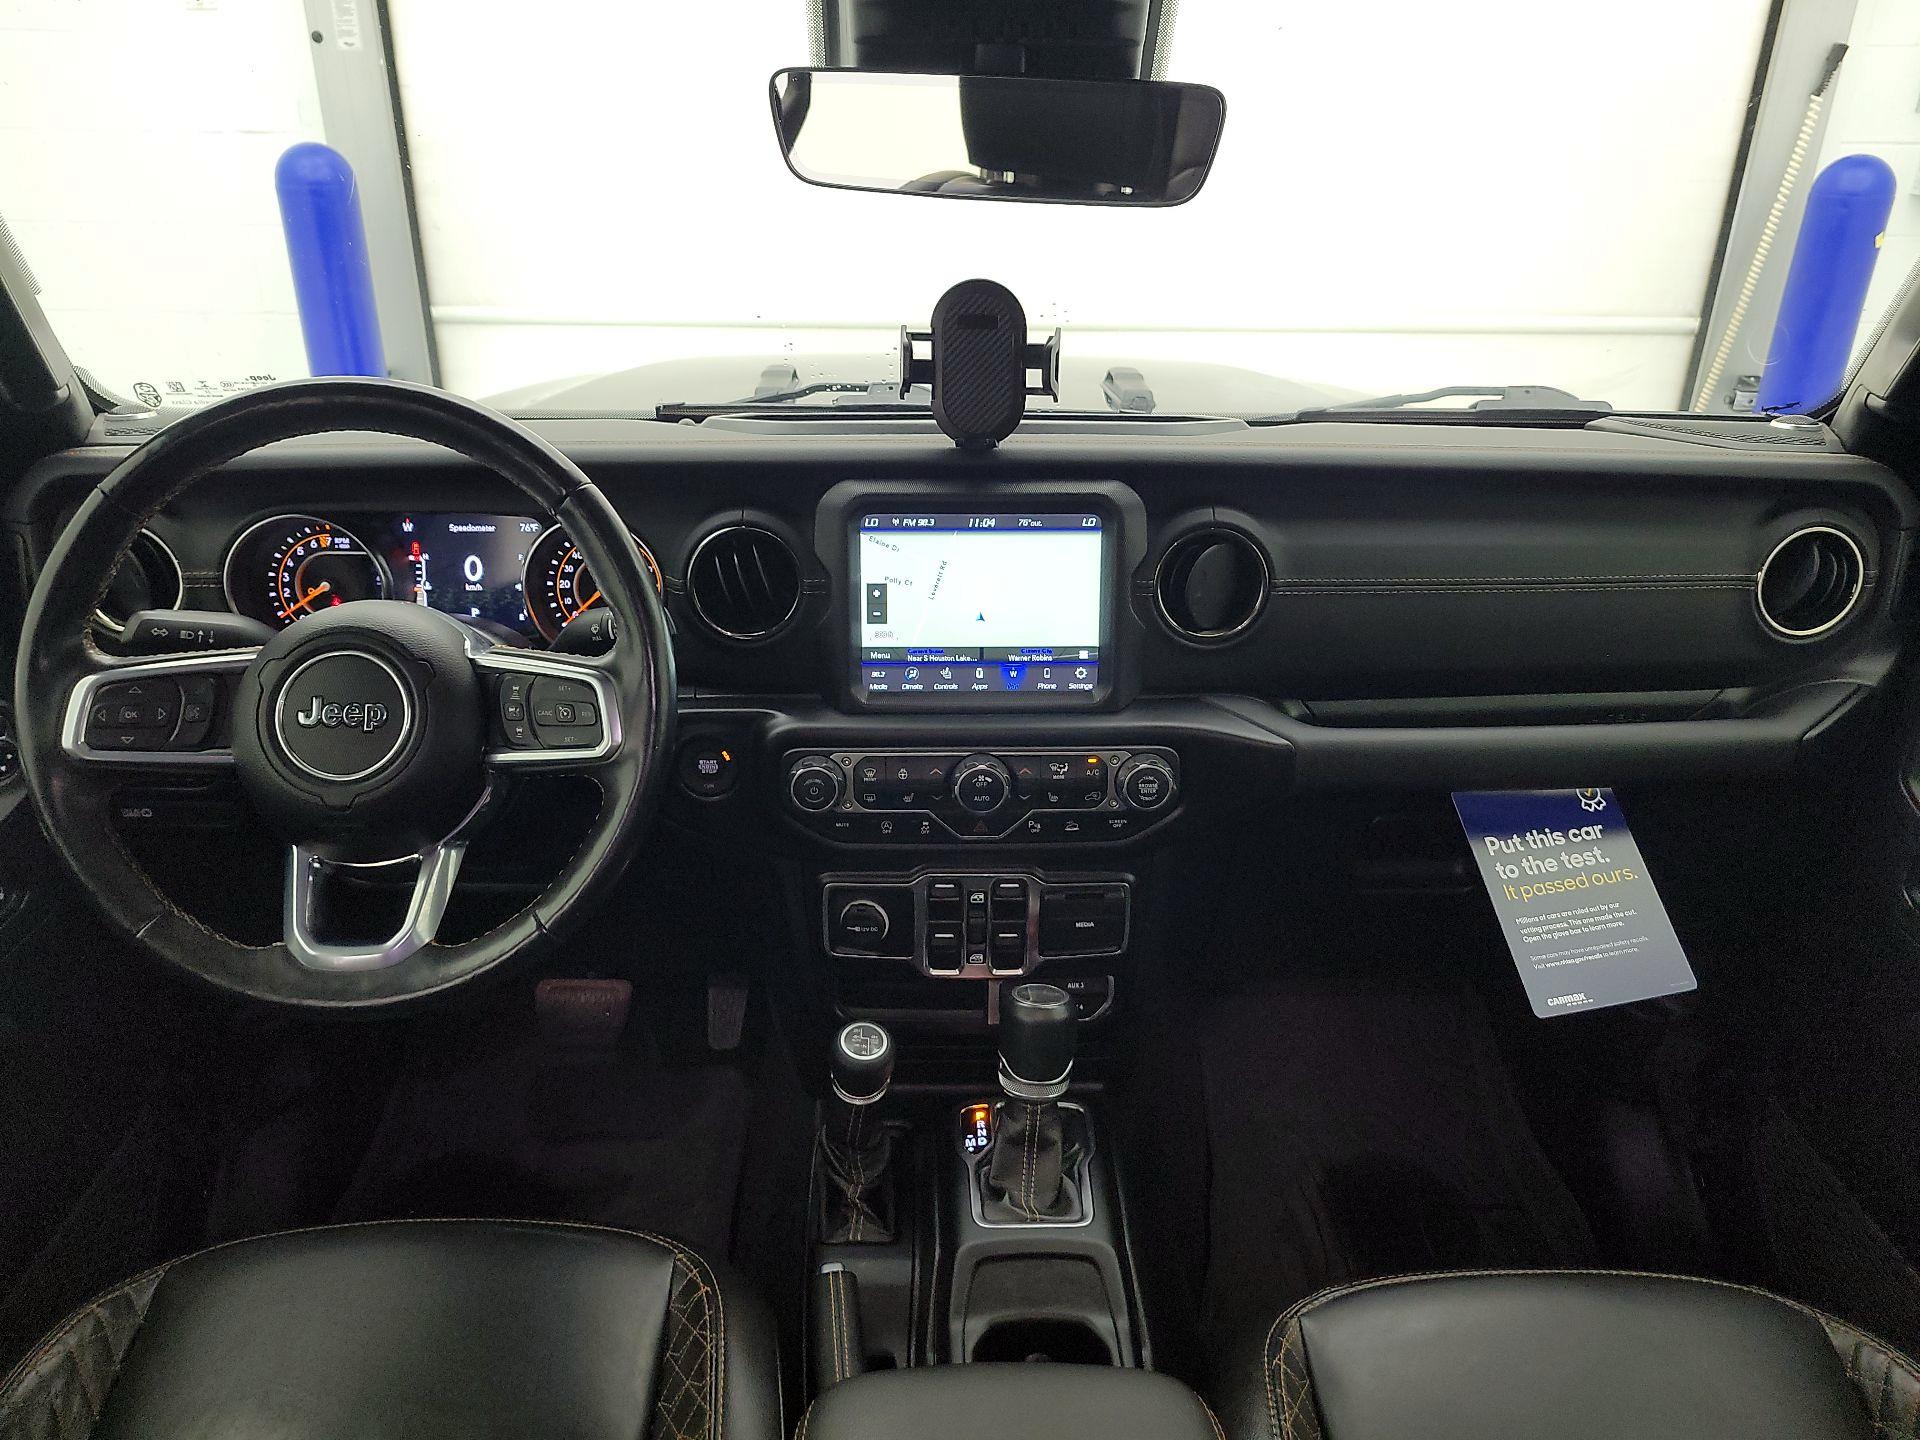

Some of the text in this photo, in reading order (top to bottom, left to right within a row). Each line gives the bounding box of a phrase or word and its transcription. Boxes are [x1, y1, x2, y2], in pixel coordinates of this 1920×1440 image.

[402, 522, 414, 532] W
[903, 518, 916, 527] FM
[969, 517, 996, 528] 11:04
[448, 523, 497, 533] Speedometer
[310, 539, 318, 549] 6
[326, 536, 332, 546] 7
[296, 546, 305, 556] 5
[286, 558, 294, 568] 4
[464, 555, 483, 581] 0
[563, 564, 574, 573] 30
[282, 572, 290, 582] 3
[884, 576, 902, 586] Polly
[559, 580, 571, 589] 20
[283, 587, 291, 598] 2
[564, 597, 572, 605] 10
[471, 607, 480, 618] P
[870, 651, 891, 660] Menu
[907, 654, 923, 662] Near
[929, 654, 955, 662] Houston
[1007, 653, 1053, 662] Warner Robins
[971, 683, 988, 691] Apps
[1068, 683, 1093, 691] Settings
[124, 711, 138, 719] OK
[297, 695, 388, 732] Jeep
[1484, 824, 1603, 856] Put this car
[1495, 846, 1611, 880] to the test.
[1503, 867, 1639, 902] It passed ours.
[1515, 915, 1539, 925] Millions
[1546, 912, 1561, 920] cars
[1561, 910, 1572, 918] are
[1572, 907, 1589, 916] ruled
[1589, 904, 1600, 913] out
[1520, 908, 1638, 935] vetting process. This one made the cut.
[1522, 934, 1541, 944] Open
[1541, 932, 1552, 940] the
[1552, 930, 1569, 940] glove
[1569, 927, 1581, 935] box
[1589, 922, 1606, 932] learn
[1606, 919, 1625, 929] more.
[975, 1111, 985, 1121] P
[976, 1120, 986, 1128] R
[977, 1128, 987, 1137] N
[965, 1137, 977, 1148] M
[977, 1136, 988, 1146] D
